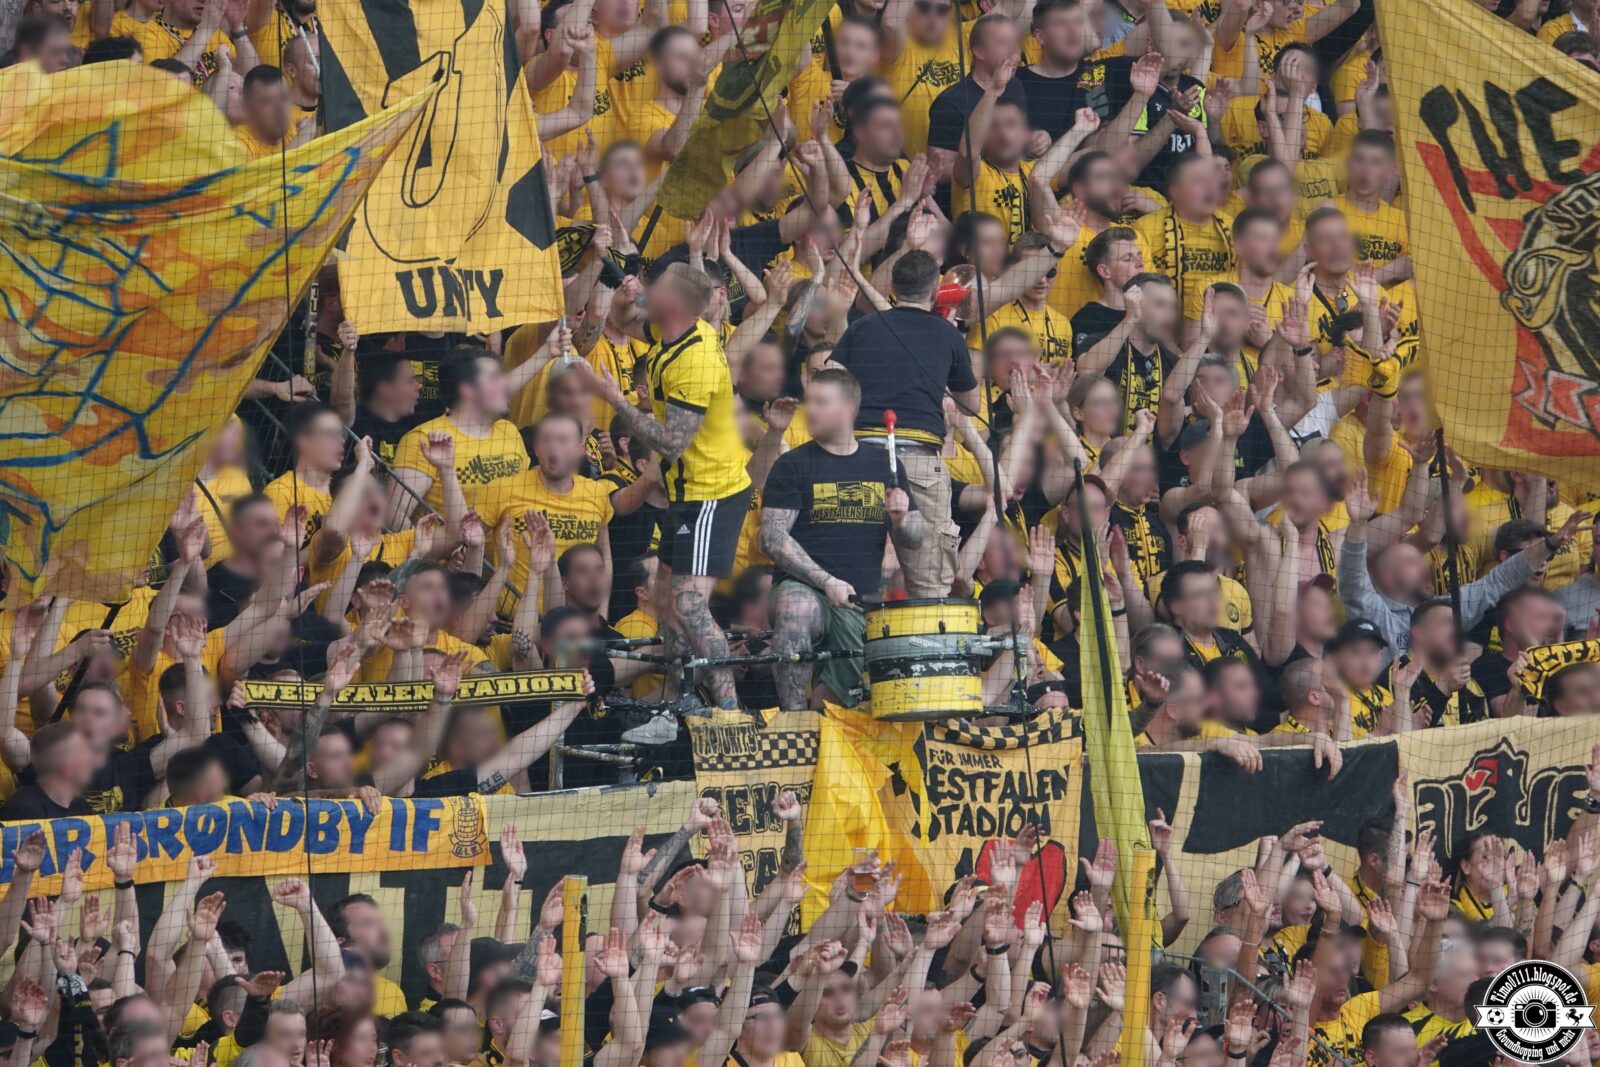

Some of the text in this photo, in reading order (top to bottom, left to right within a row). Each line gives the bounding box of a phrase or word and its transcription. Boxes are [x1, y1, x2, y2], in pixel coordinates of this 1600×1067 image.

[929, 749, 1004, 769] FÜR IMMER
[926, 764, 1070, 806] ESTFALEN
[389, 797, 445, 853] IF
